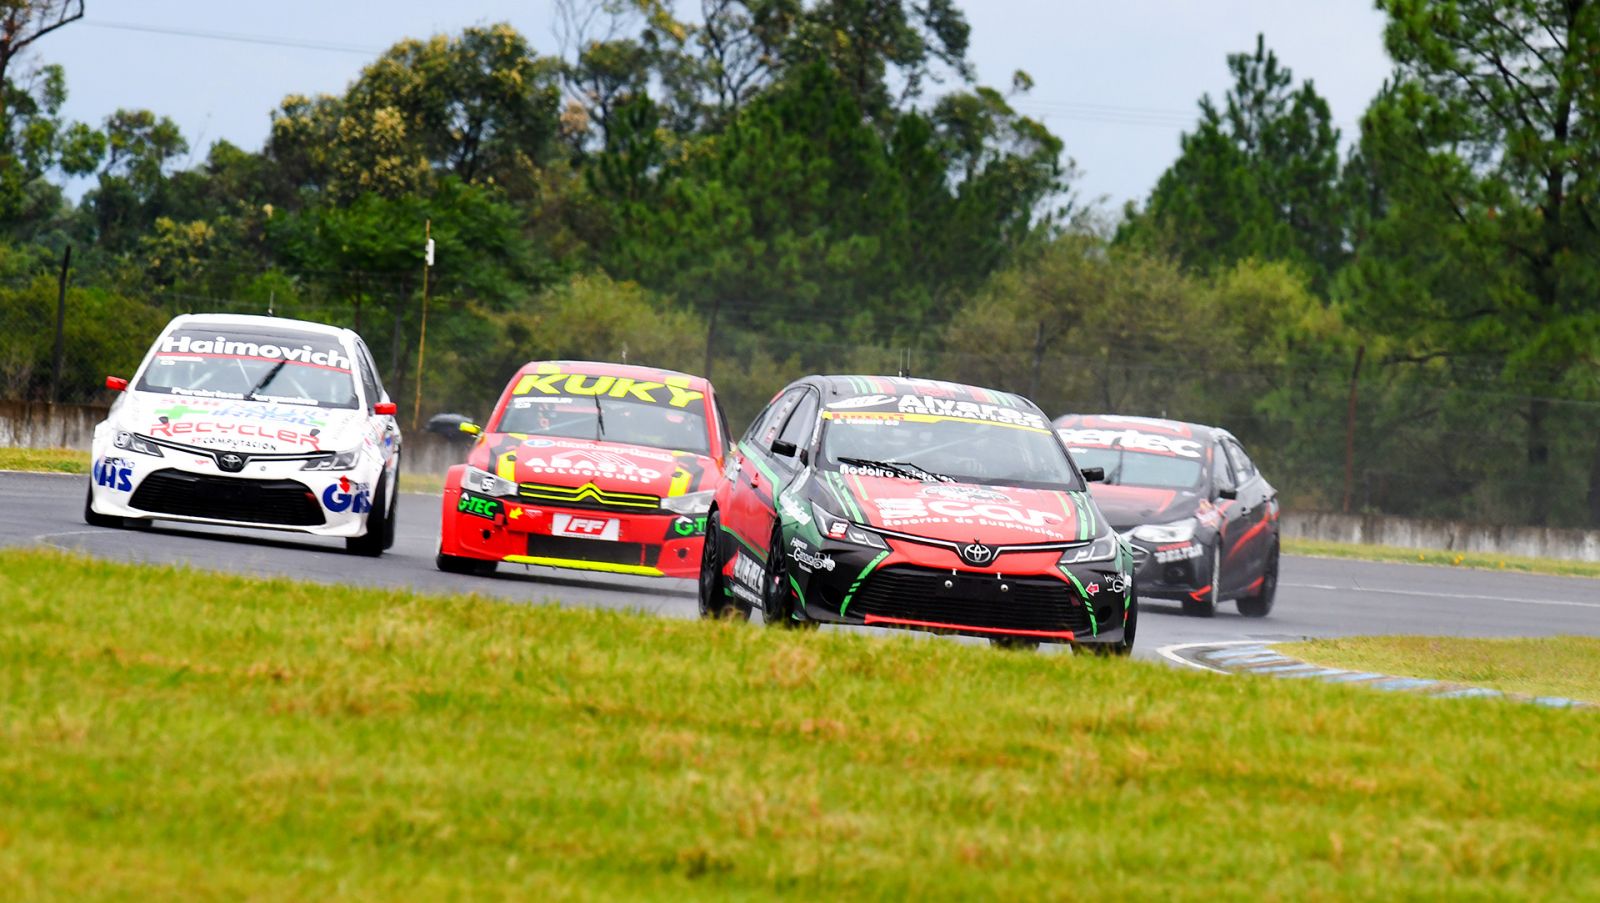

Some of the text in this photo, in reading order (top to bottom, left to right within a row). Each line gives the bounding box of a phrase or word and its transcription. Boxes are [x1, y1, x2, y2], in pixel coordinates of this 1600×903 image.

[161, 336, 350, 370] Haimovich
[512, 374, 704, 408] KUKY
[898, 394, 1042, 421] Alvarez
[525, 458, 662, 479] ABASTO
[570, 518, 603, 532] FF
[954, 515, 974, 525] de
